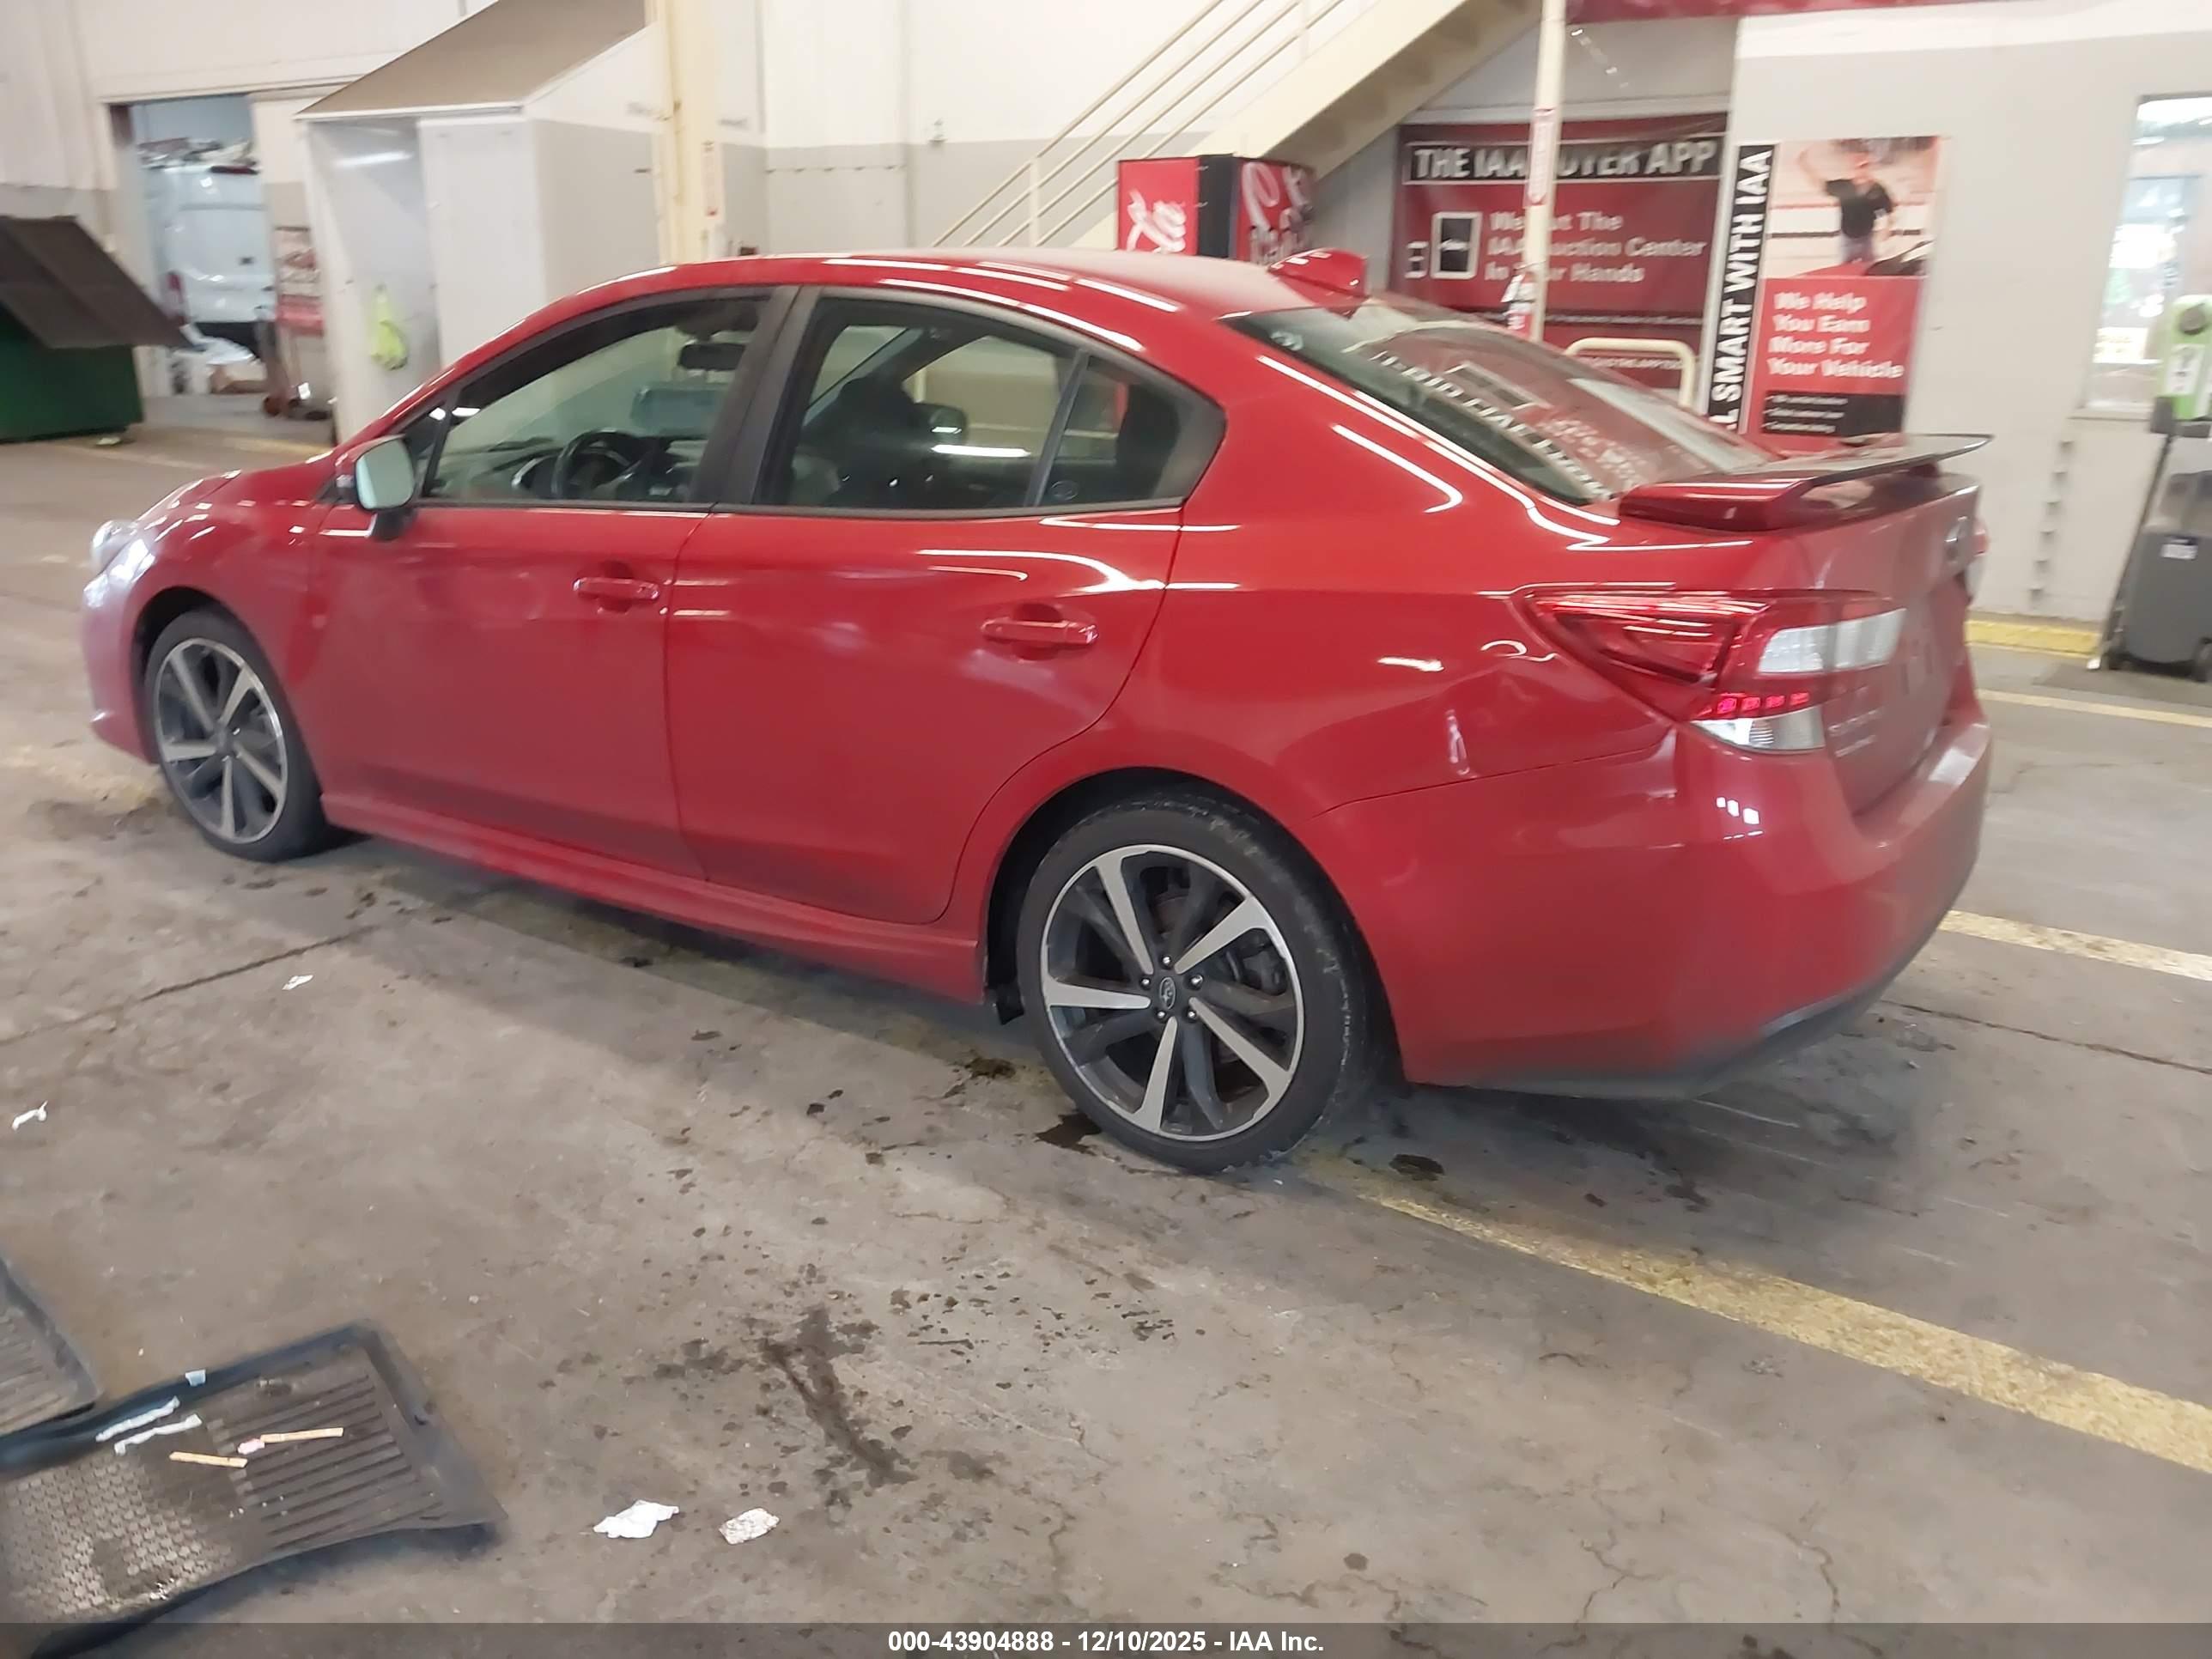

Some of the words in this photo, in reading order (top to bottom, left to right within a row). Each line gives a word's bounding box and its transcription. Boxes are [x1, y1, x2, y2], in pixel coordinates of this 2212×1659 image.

[1414, 148, 1470, 178] THE
[1644, 141, 1717, 175] APP
[1735, 149, 1772, 205] IAA
[1577, 211, 1623, 231] The
[1550, 238, 1623, 257] uction
[1625, 236, 1707, 257] Center
[1723, 214, 1764, 293] WITH
[1485, 261, 1510, 281] In
[1570, 262, 1645, 283] Hands
[1774, 292, 1811, 310] We
[1812, 292, 1867, 314] Help
[1772, 313, 1815, 331] You
[1816, 314, 1870, 332] Earn
[1711, 298, 1753, 402] SMART
[1768, 336, 1827, 353] More
[1828, 337, 1870, 355] For
[1766, 357, 1819, 374] Your
[1820, 359, 1905, 378] Vehicle
